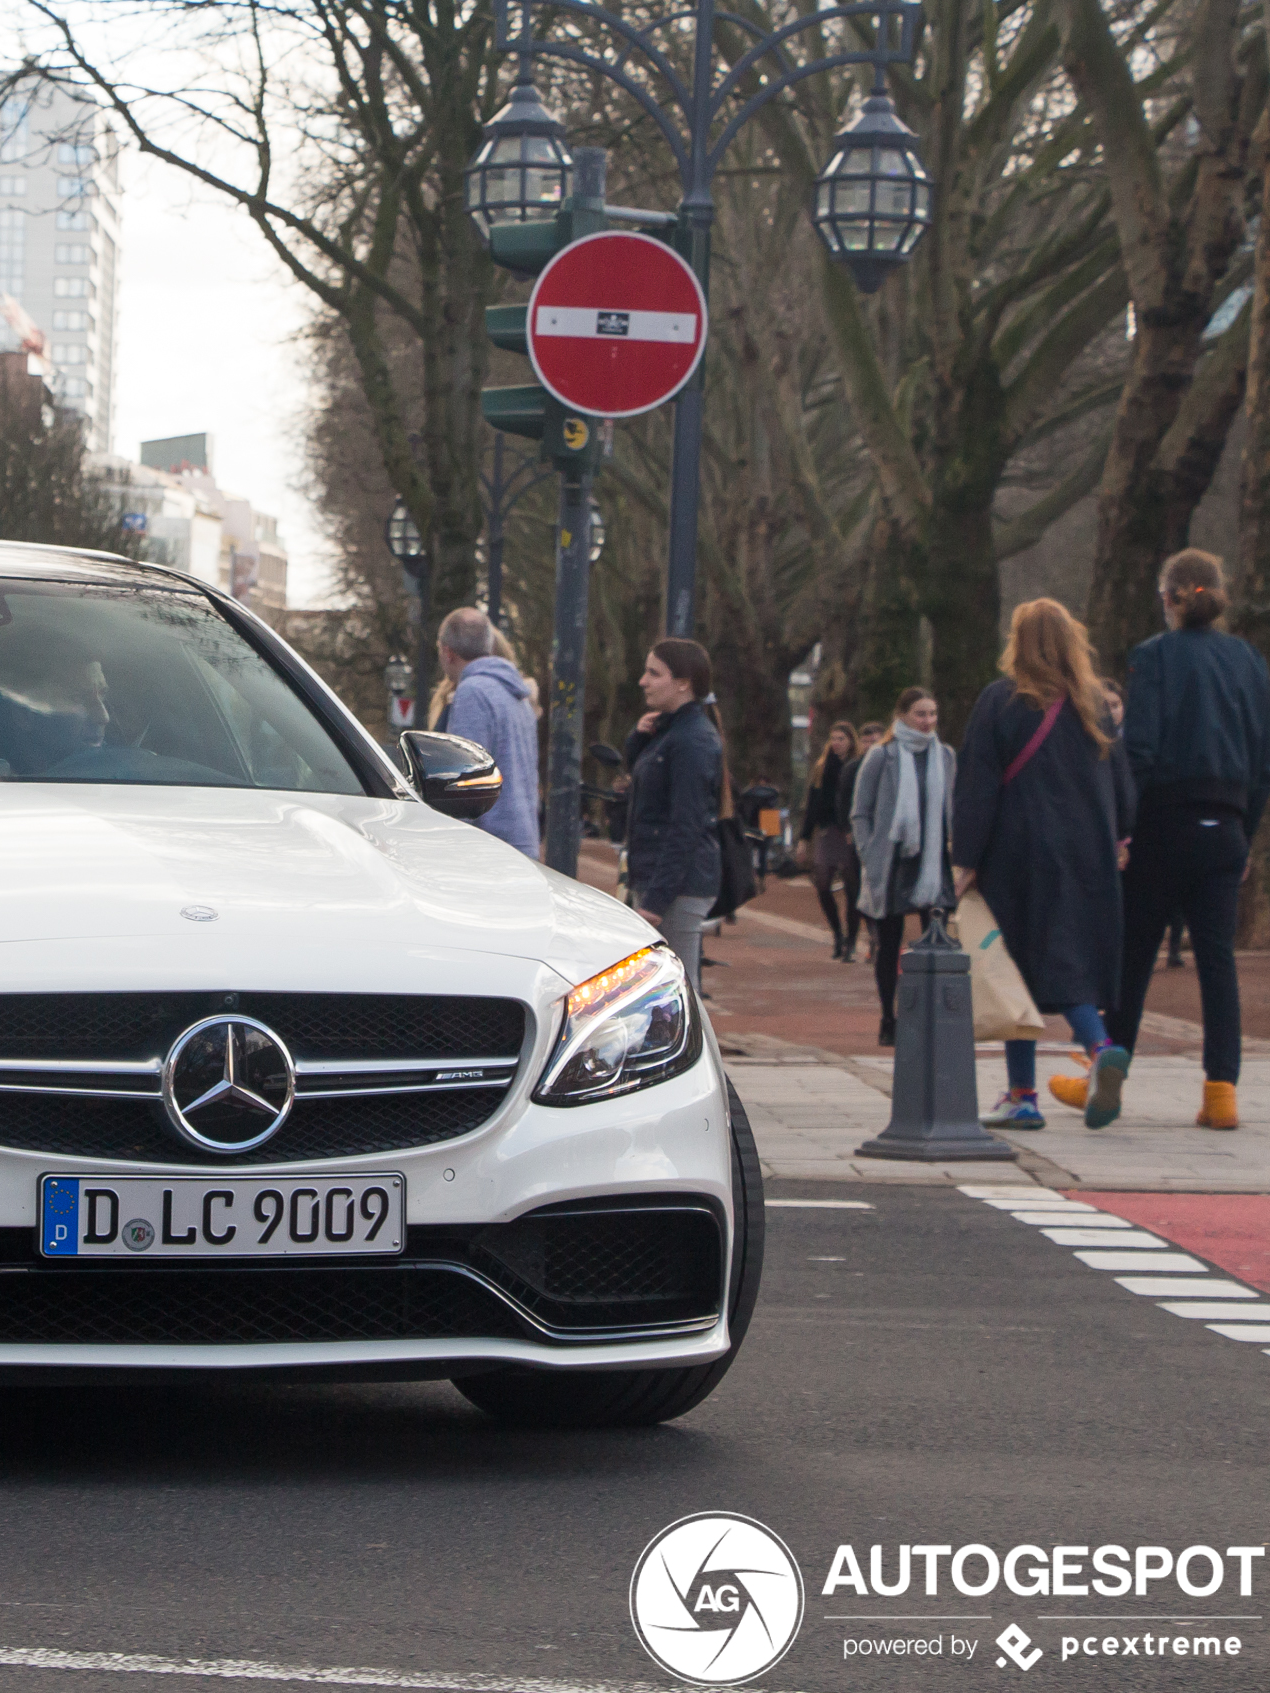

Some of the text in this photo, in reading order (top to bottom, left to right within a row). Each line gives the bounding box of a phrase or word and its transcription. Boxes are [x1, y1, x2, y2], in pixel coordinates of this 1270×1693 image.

[450, 1071, 484, 1079] AMG
[83, 1186, 390, 1245] D LC 9009
[55, 1225, 67, 1240] D
